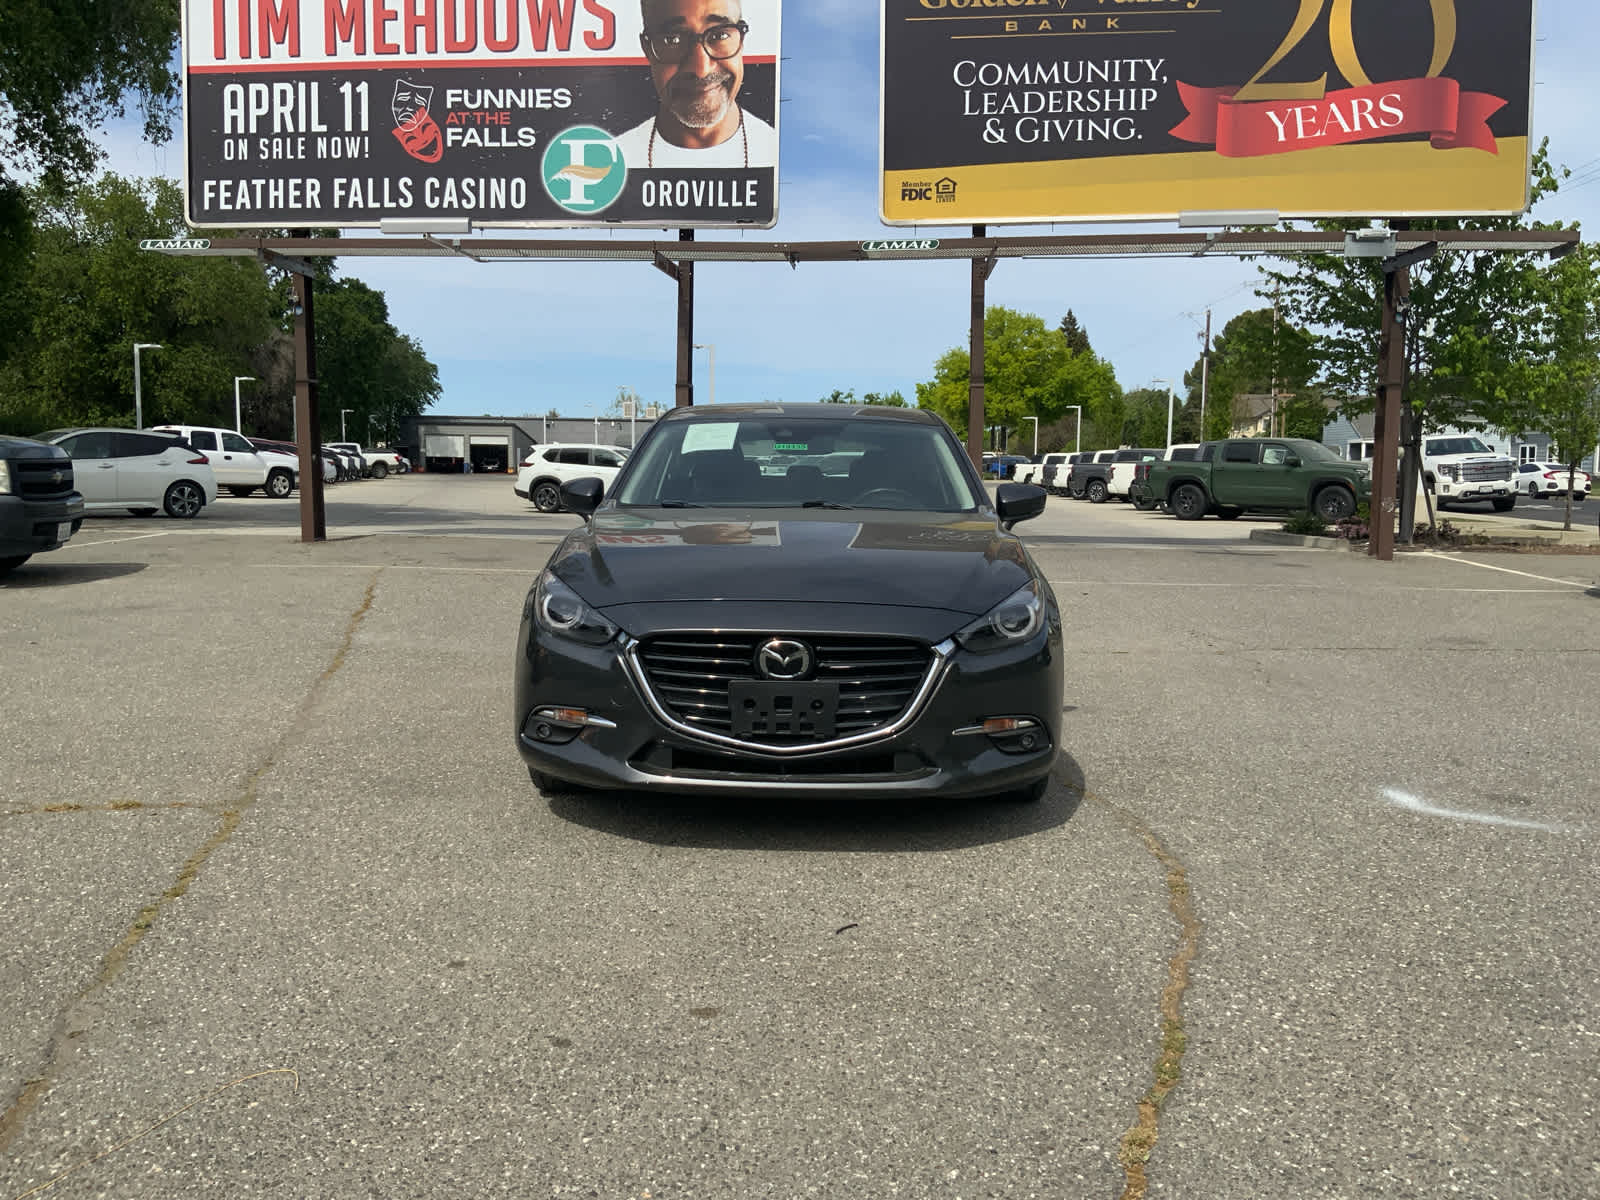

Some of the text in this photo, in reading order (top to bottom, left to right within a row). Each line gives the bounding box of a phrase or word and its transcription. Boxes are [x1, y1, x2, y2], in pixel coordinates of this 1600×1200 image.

[1005, 17, 1120, 32] BANK
[952, 58, 1168, 87] COMMUNITY,
[224, 81, 369, 134] APRIL 11
[446, 87, 573, 109] FUNNIES
[963, 88, 1158, 116] LEADERSHIP
[446, 111, 511, 125] AT THE
[982, 117, 1143, 144] & GIVING.
[1265, 94, 1404, 142] YEARS
[224, 136, 370, 161] ON SALE NOW!
[446, 127, 536, 148] FALLS
[203, 177, 527, 210] FEATHER FALLS CASINO
[641, 180, 758, 207] OROVILLE
[901, 188, 932, 201] FDIC
[145, 239, 204, 250] LAMAR
[867, 239, 932, 251] LAMAR
